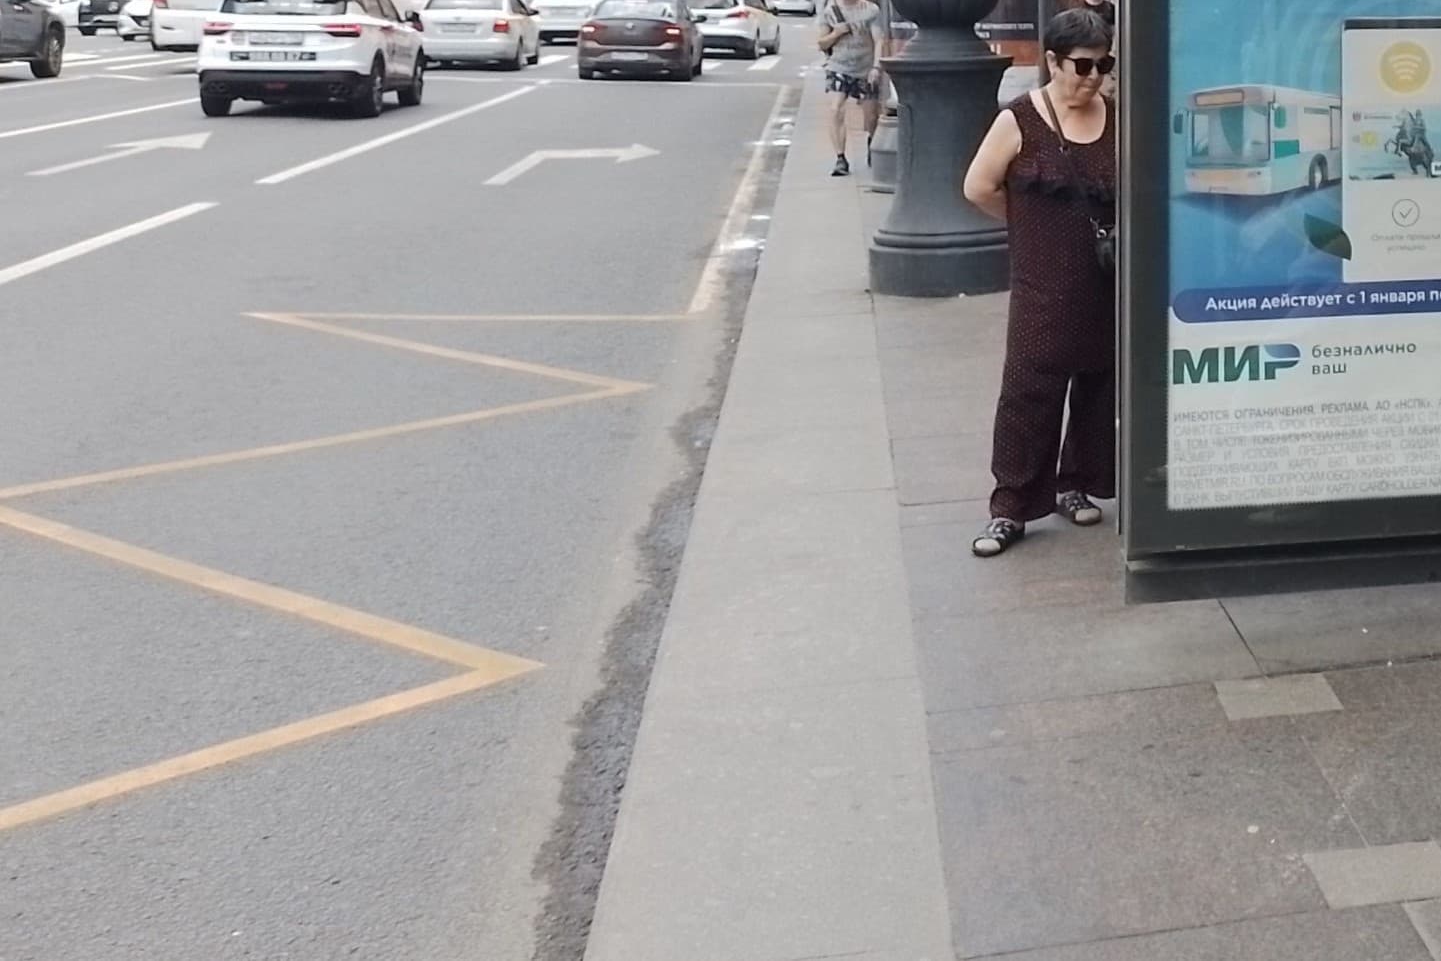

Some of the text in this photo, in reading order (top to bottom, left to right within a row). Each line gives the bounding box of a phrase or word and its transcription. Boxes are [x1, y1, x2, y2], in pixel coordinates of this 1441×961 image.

[1205, 295, 1257, 311] Акция
[1261, 291, 1342, 311] действует
[1346, 293, 1356, 304] с
[1359, 290, 1366, 304] 1
[1370, 289, 1426, 304] января
[1311, 341, 1417, 359] безналично
[1172, 343, 1301, 385] МИР
[1311, 361, 1348, 376] ваш
[1174, 409, 1229, 422] ИМЕЮТСЯ
[1321, 401, 1369, 414] РЕКЛАМА
[1375, 400, 1391, 411] АО
